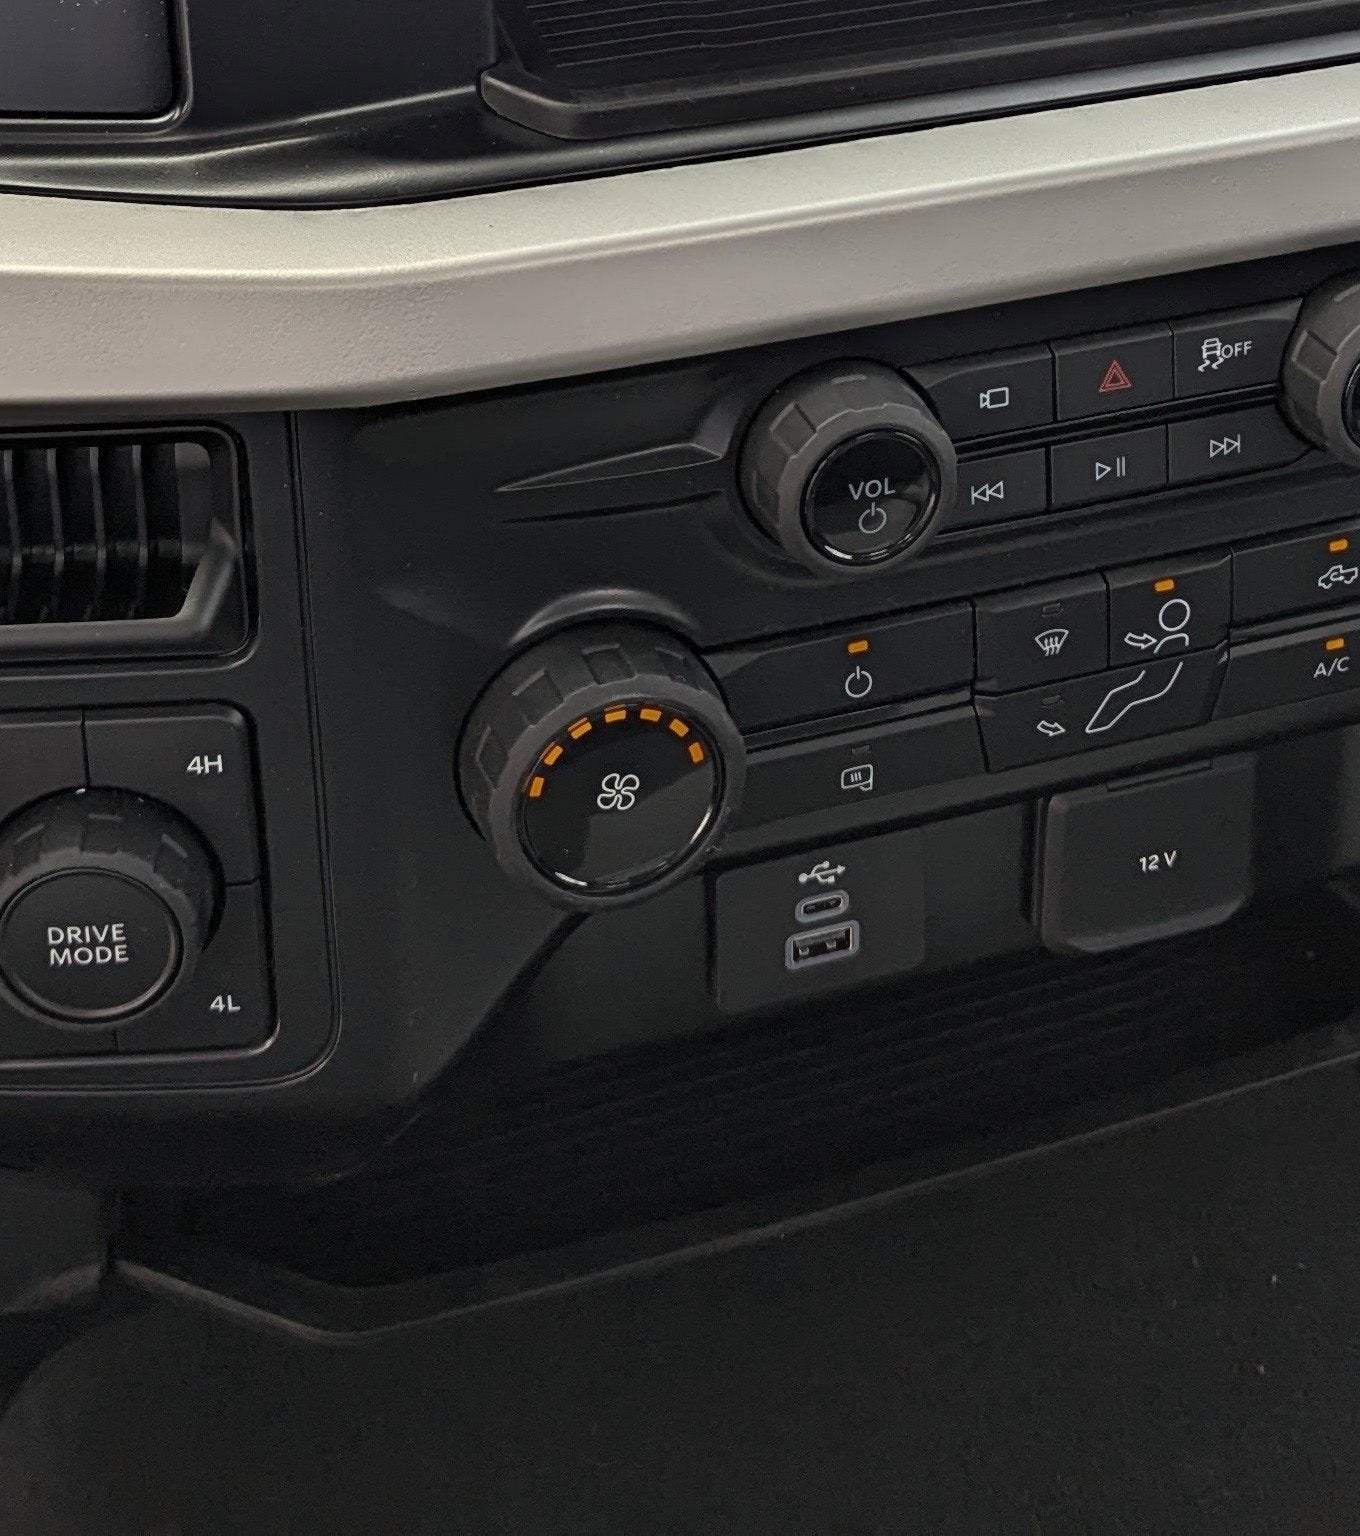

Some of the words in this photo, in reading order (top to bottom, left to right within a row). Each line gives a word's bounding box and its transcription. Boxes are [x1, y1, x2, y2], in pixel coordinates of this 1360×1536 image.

[1220, 339, 1253, 361] OFF
[848, 476, 897, 501] VOL
[1313, 655, 1351, 679] A/C
[186, 753, 224, 776] 4H
[46, 922, 127, 946] DRIVE
[48, 944, 130, 967] MODE
[209, 994, 241, 1014] 4L
